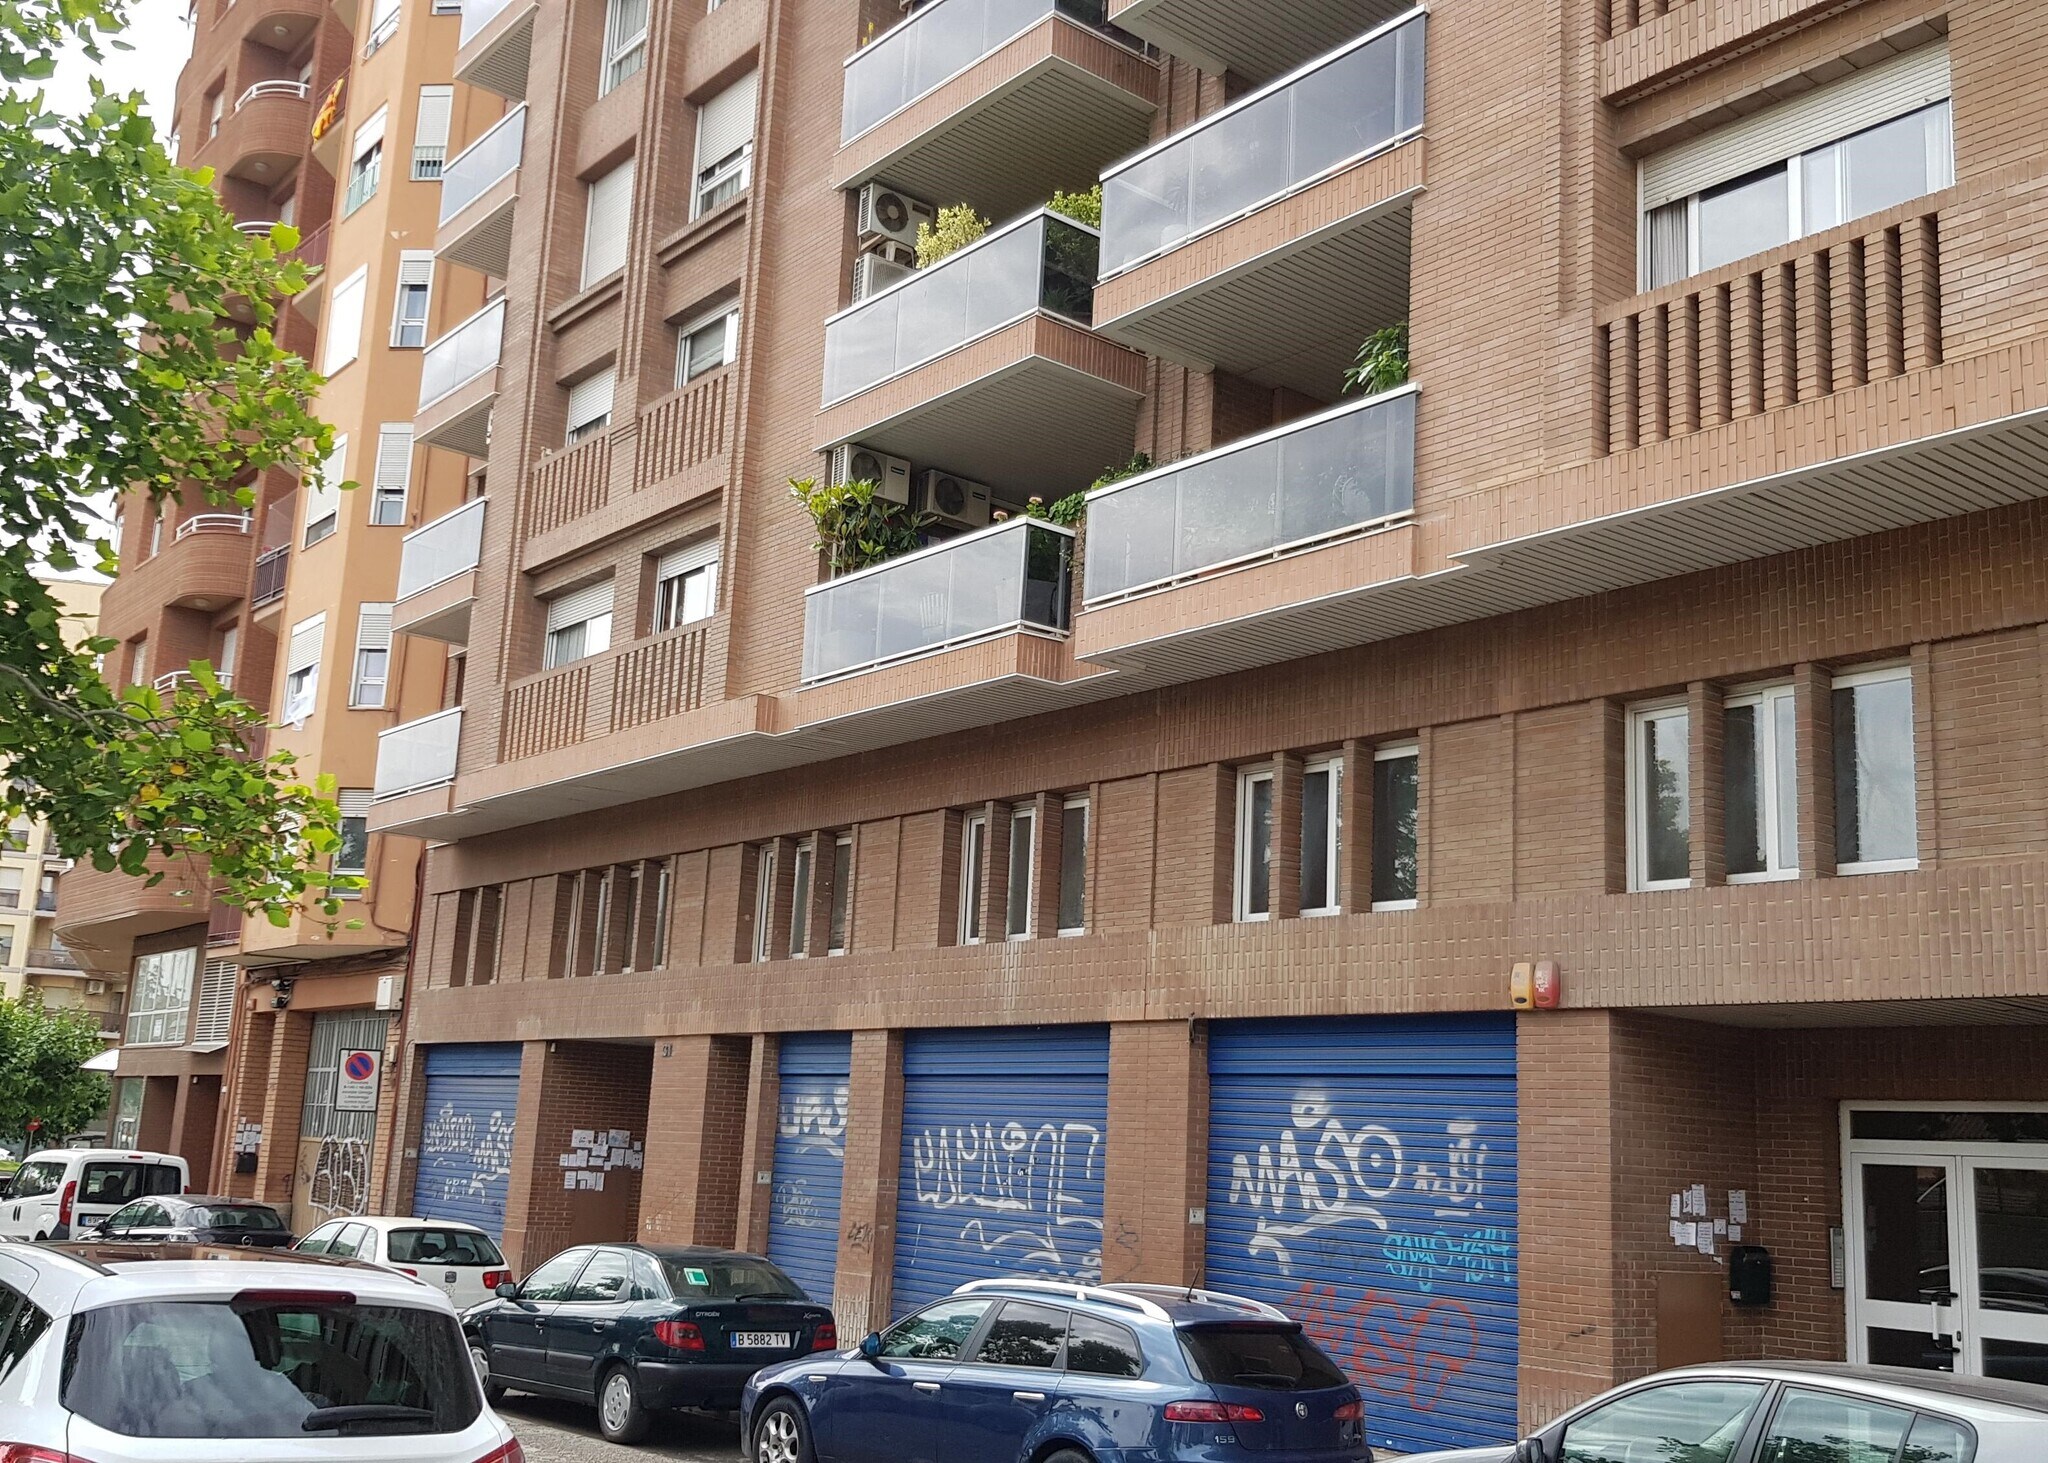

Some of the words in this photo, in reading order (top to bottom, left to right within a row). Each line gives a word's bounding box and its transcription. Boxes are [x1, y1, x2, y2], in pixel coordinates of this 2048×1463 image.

[738, 1333, 745, 1346] B
[747, 1333, 772, 1346] 5882
[774, 1333, 787, 1346] TV
[1214, 1435, 1235, 1444] 159
